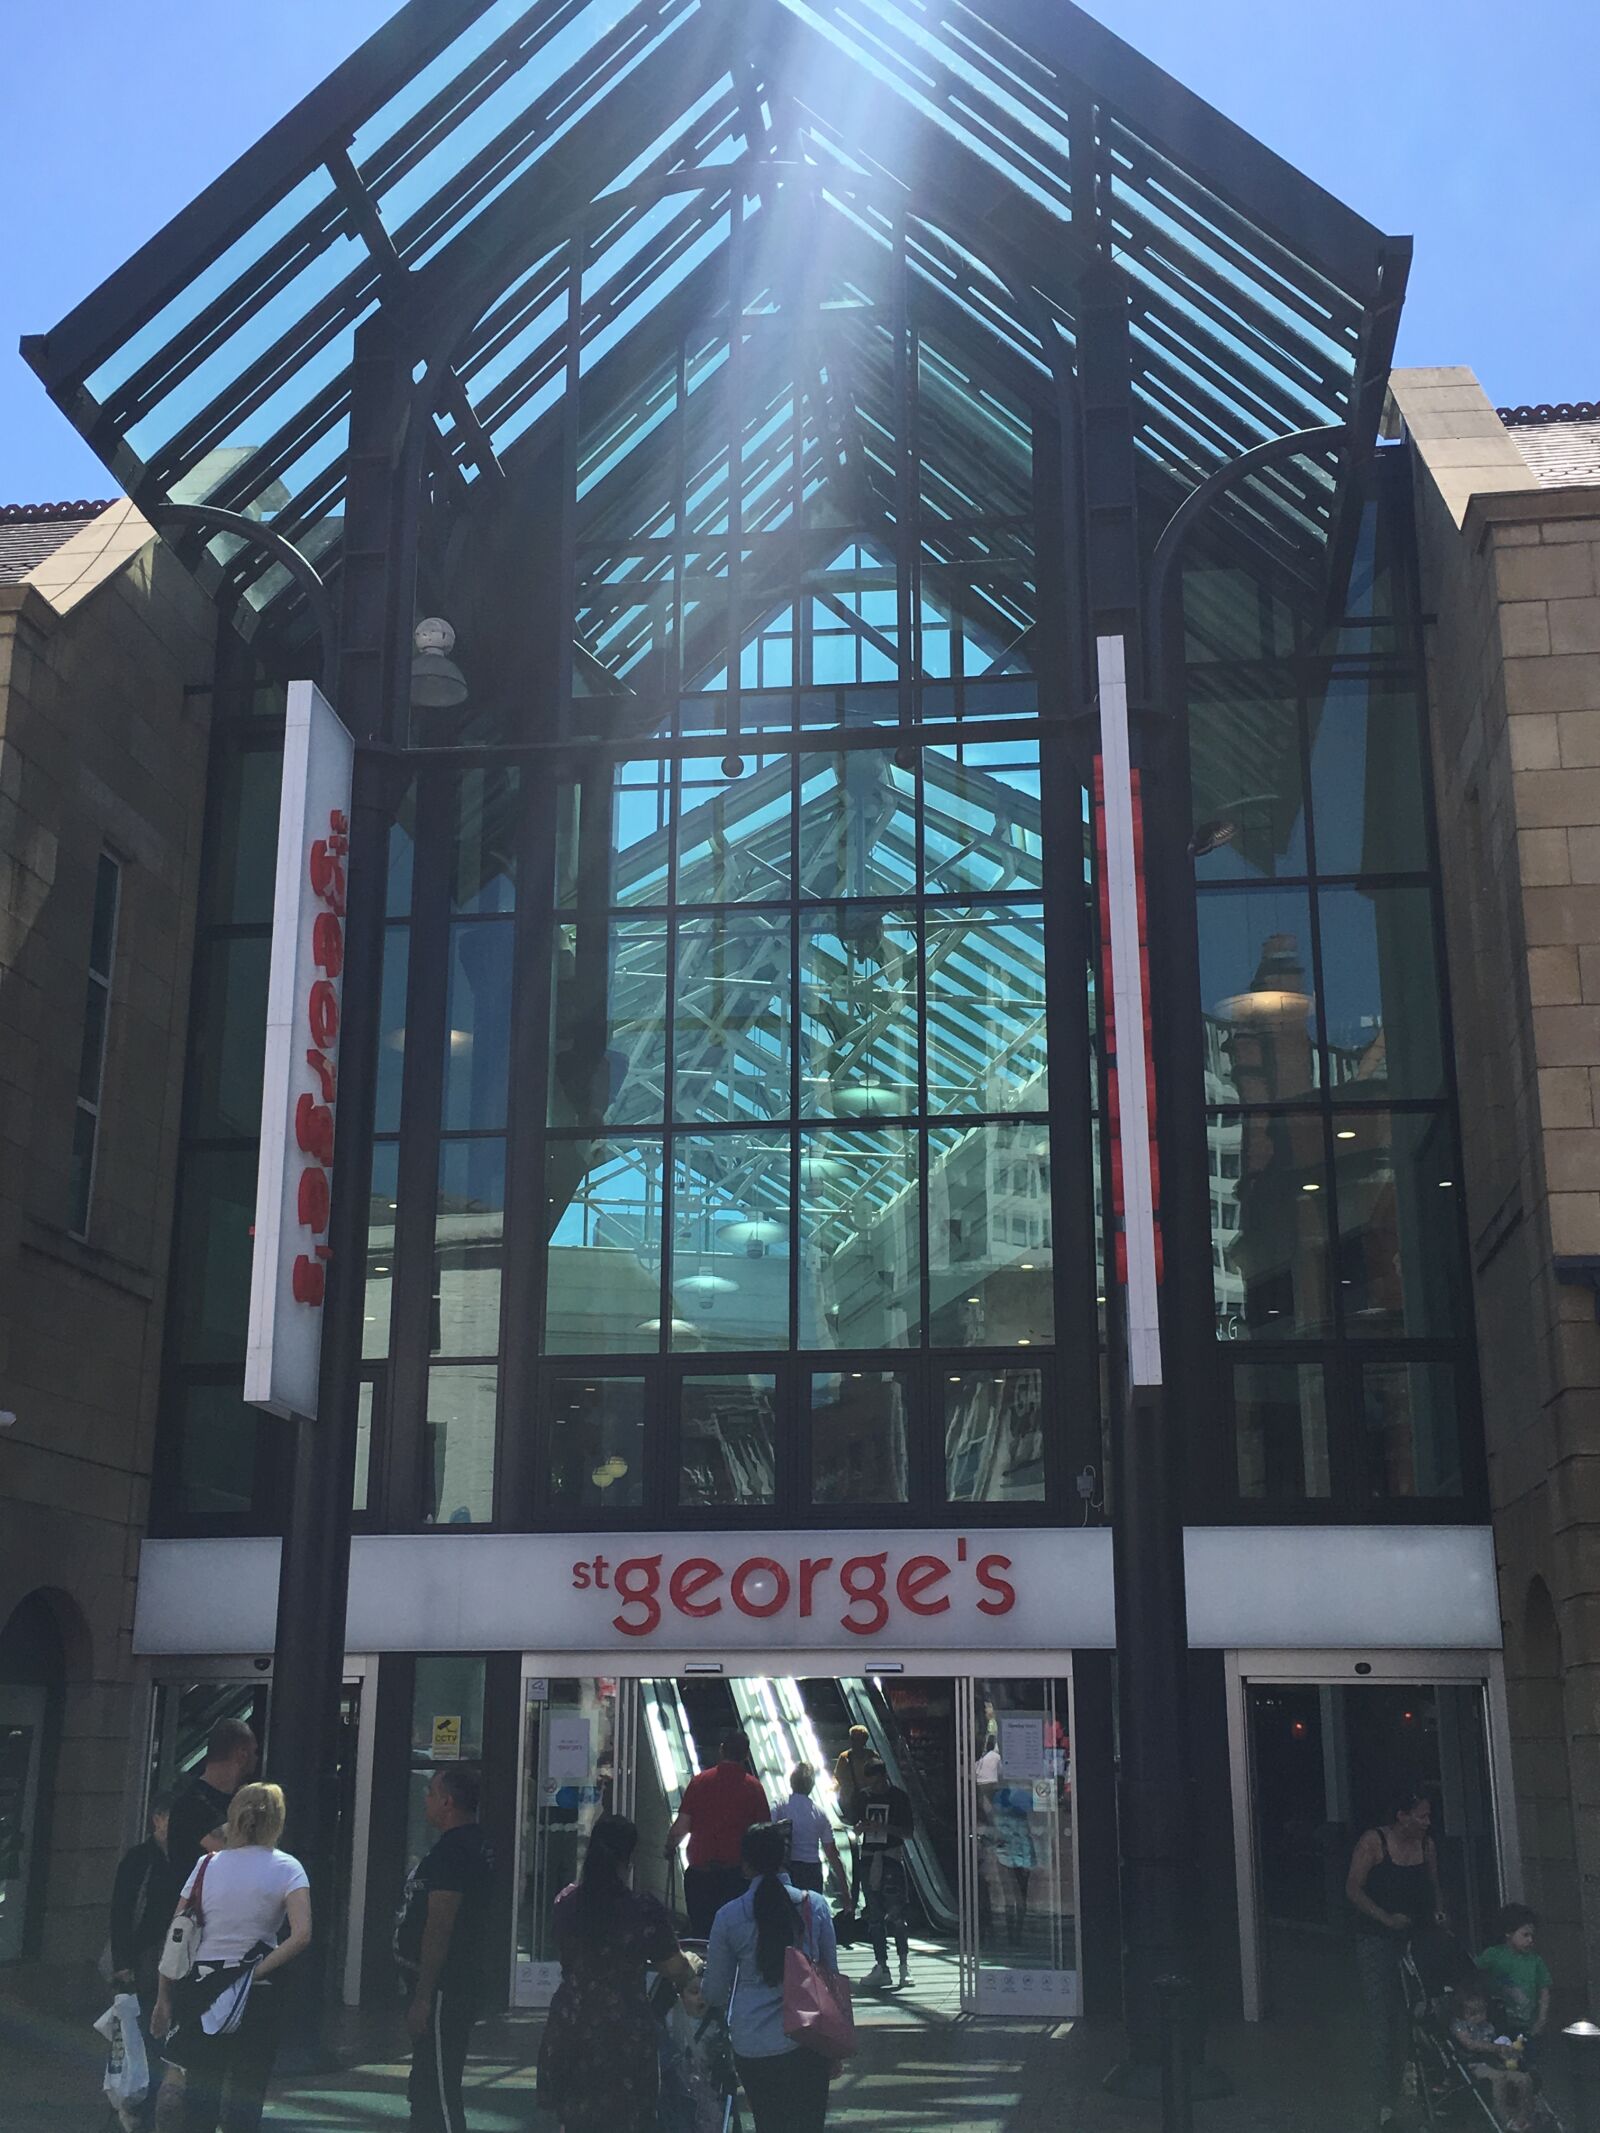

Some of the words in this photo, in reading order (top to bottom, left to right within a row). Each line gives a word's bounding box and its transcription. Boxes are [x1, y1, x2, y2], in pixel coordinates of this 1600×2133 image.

[572, 1555, 609, 1590] st
[612, 1537, 1016, 1637] george's
[435, 1734, 457, 1742] CCTV
